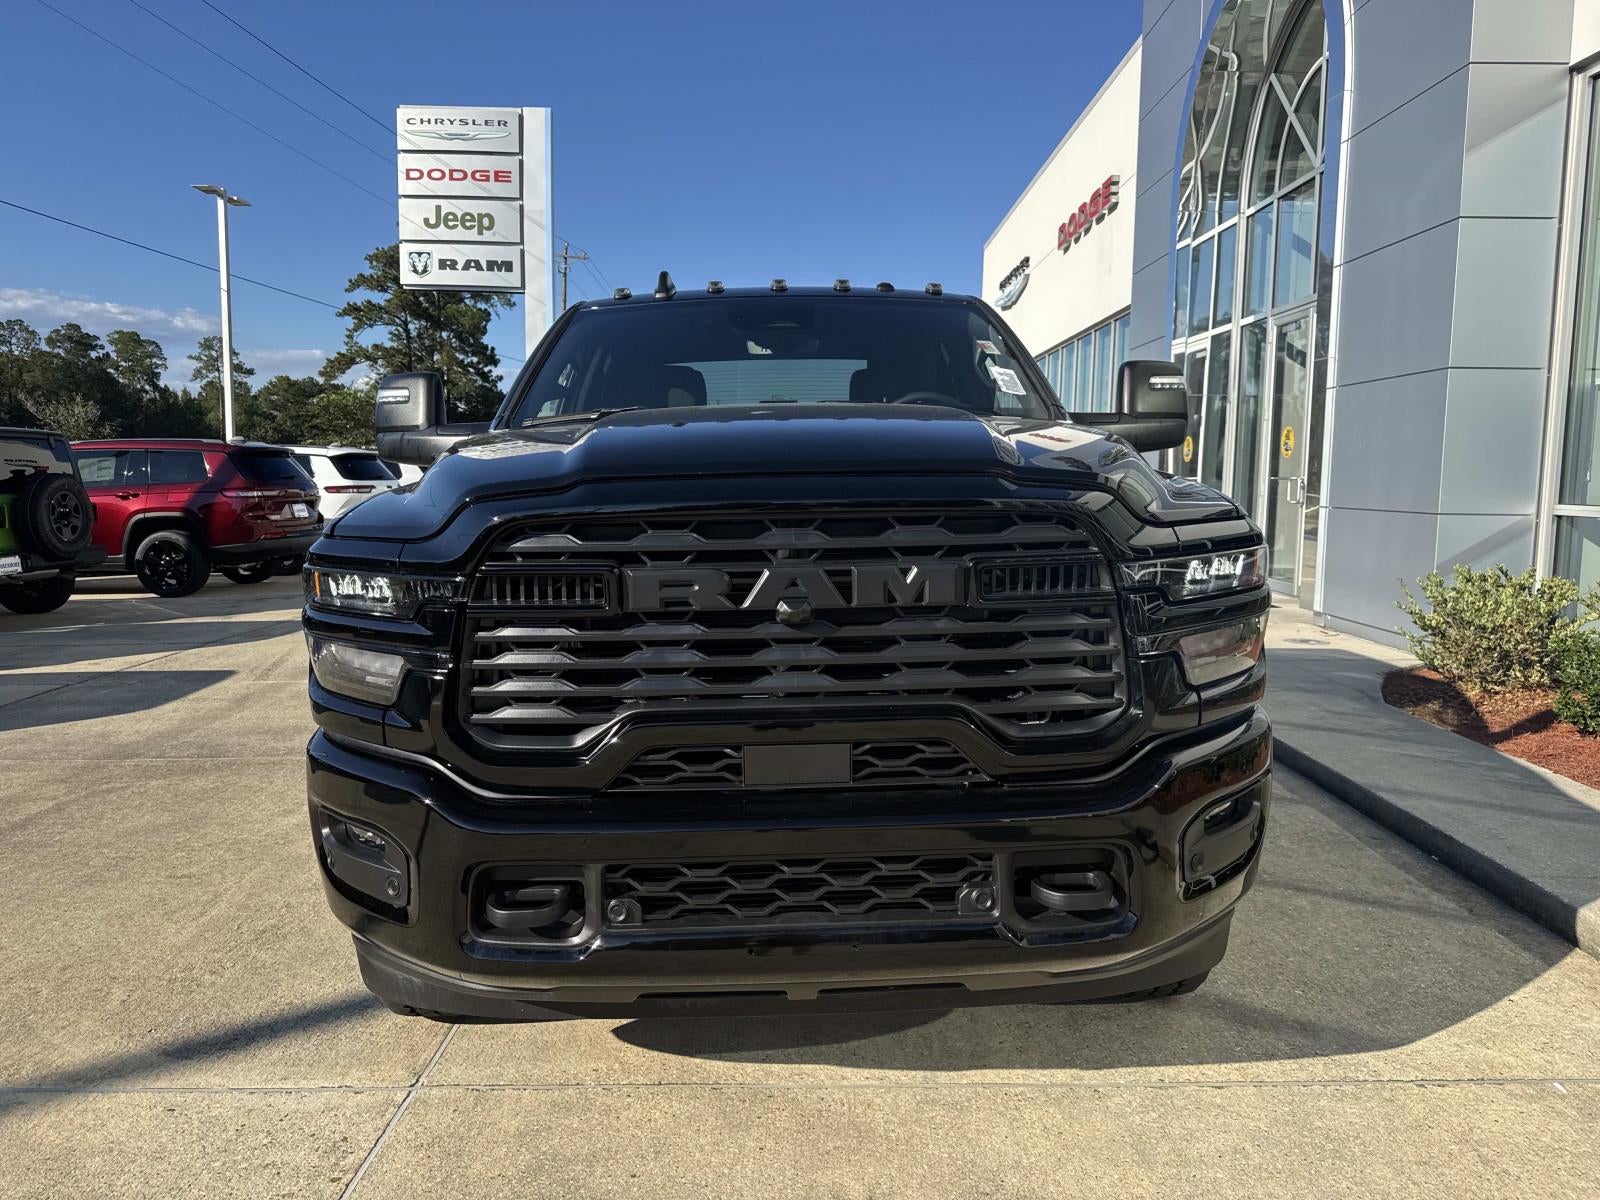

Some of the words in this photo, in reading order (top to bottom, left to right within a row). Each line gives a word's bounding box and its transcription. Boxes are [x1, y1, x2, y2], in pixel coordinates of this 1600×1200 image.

[406, 117, 509, 127] CHRYSLER
[405, 168, 513, 183] DODGE
[423, 204, 495, 236] Jeep
[1057, 174, 1120, 252] DODGE
[438, 258, 513, 273] RAM
[624, 564, 962, 612] RAM
